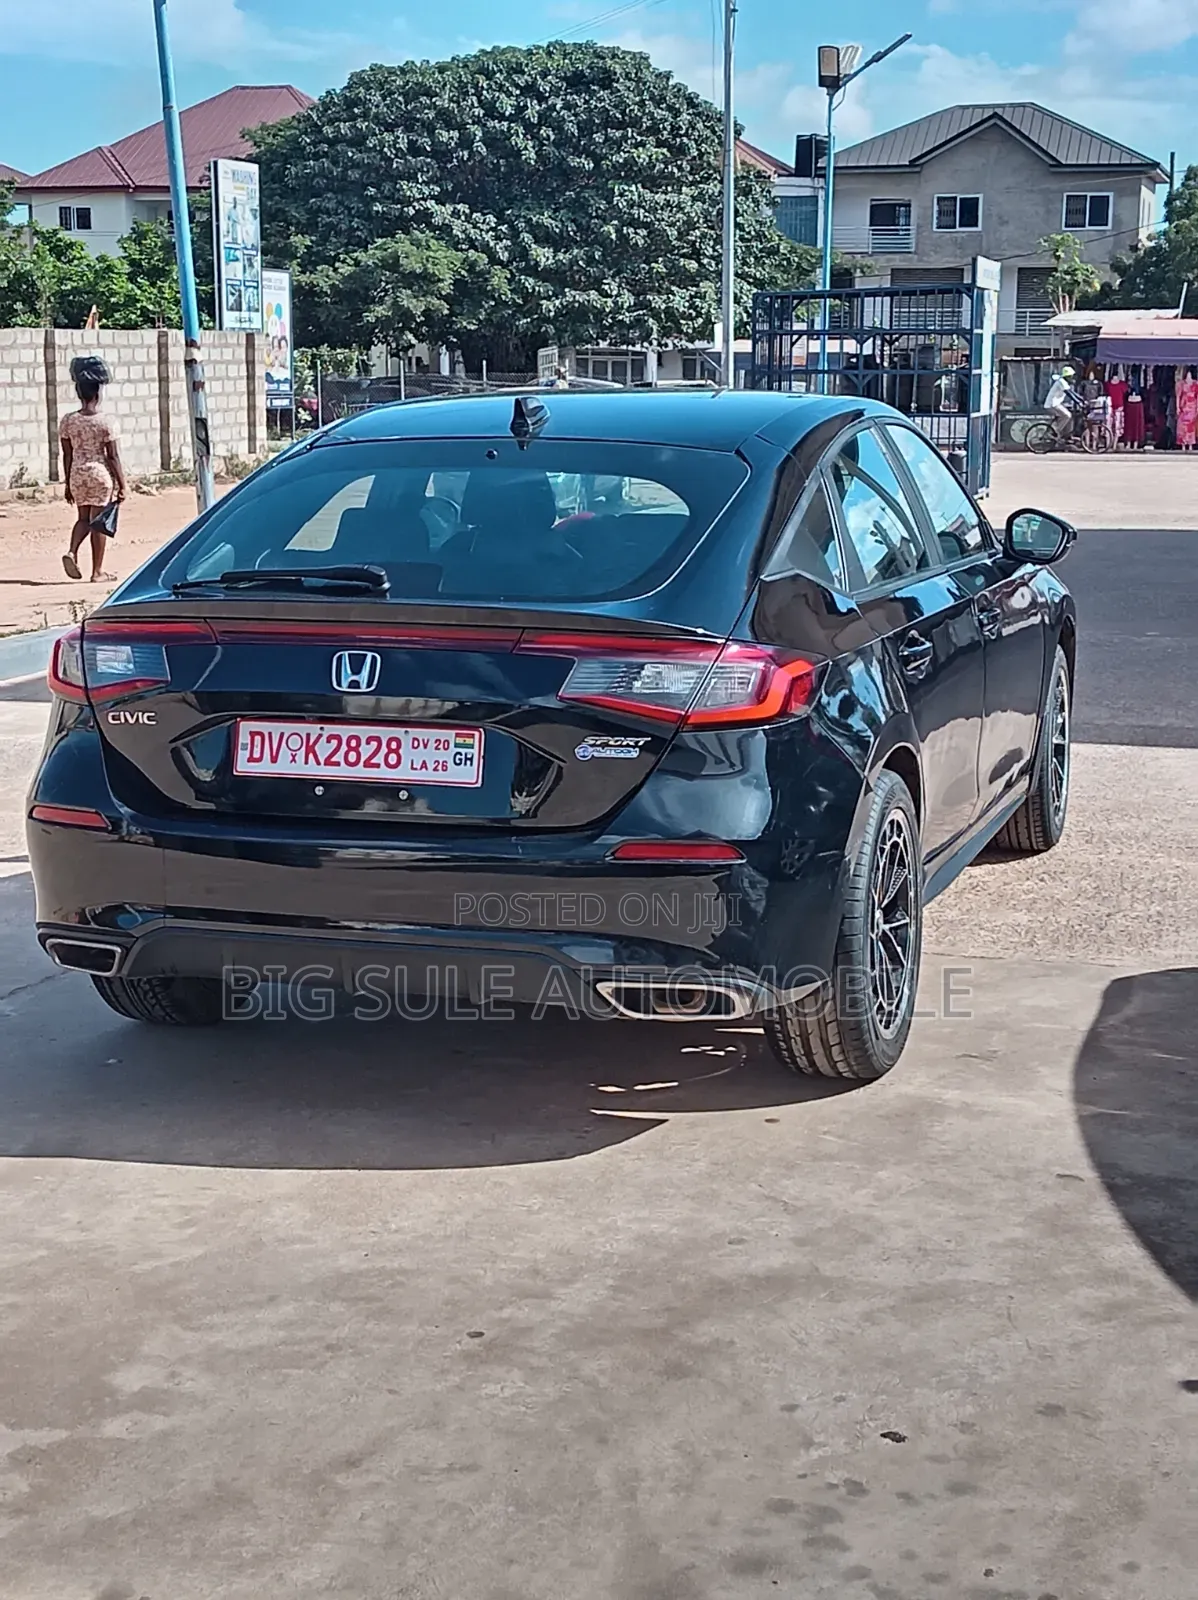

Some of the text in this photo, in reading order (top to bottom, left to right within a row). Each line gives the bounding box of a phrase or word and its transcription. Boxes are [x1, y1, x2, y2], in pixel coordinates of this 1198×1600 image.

[107, 711, 157, 725] CIVIC
[411, 737, 450, 752] DV 20
[581, 736, 651, 746] SPORT
[303, 732, 403, 770] K2828
[410, 759, 449, 773] LA 26
[452, 751, 474, 768] GH
